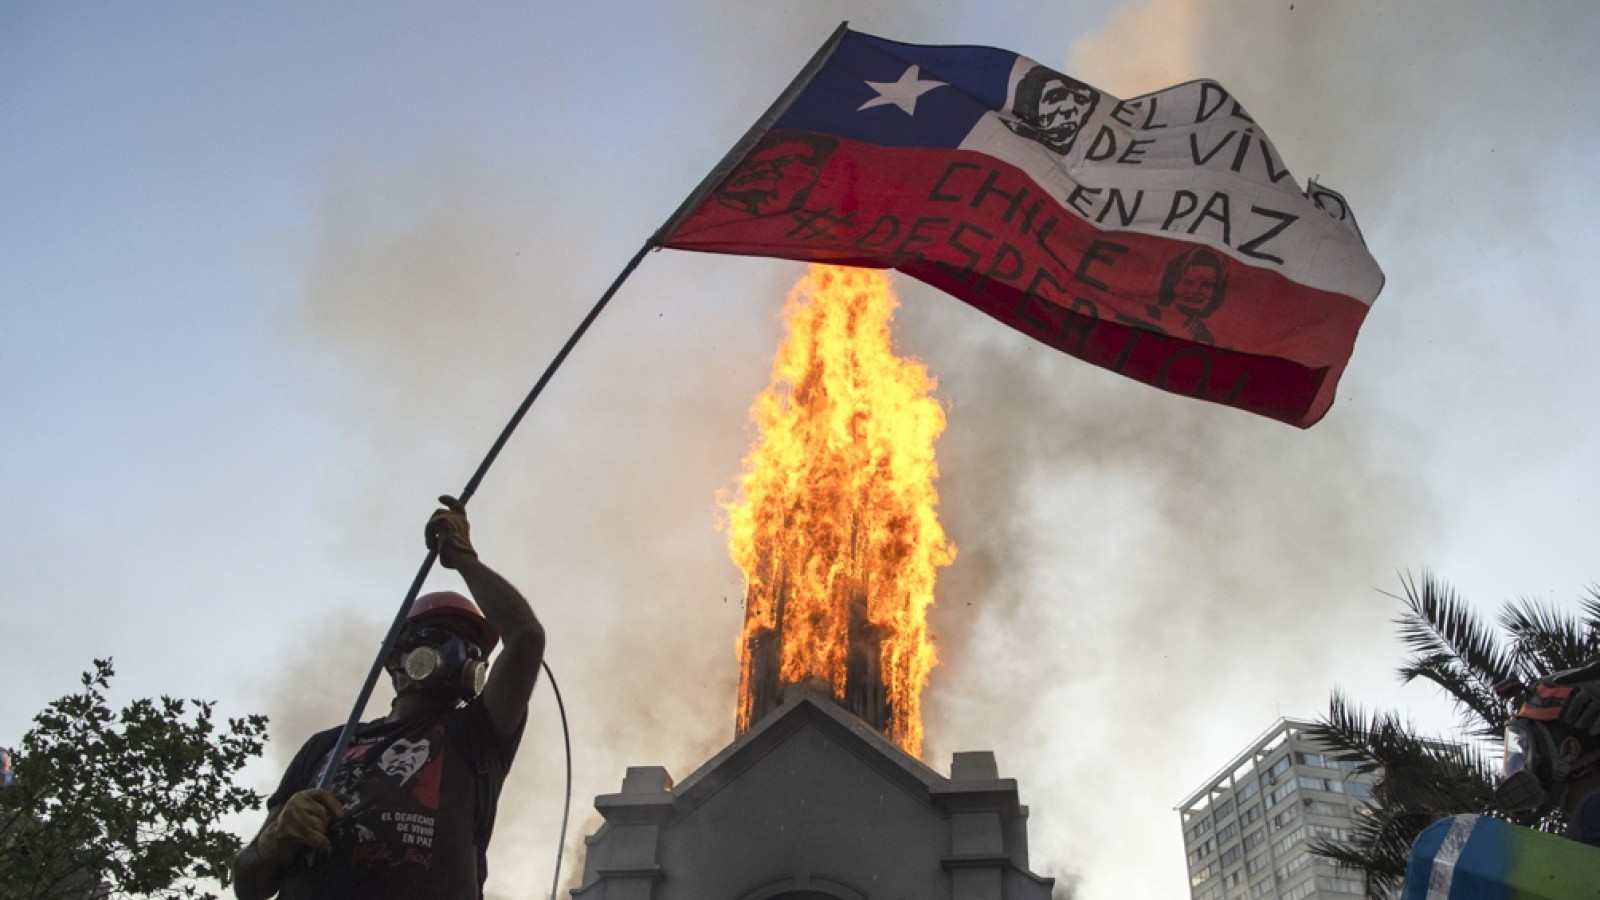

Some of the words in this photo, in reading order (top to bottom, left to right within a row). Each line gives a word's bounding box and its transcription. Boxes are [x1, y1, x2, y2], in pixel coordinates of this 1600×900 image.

[1110, 97, 1167, 130] EL
[1085, 124, 1156, 164] DE
[1066, 184, 1144, 227] EN
[1160, 189, 1300, 266] PAZ
[381, 811, 392, 821] EL
[394, 811, 435, 827] DERECHO
[396, 822, 409, 832] DE
[411, 824, 434, 837] VIVIR
[402, 832, 415, 844] EN
[416, 835, 433, 848] PAZ
